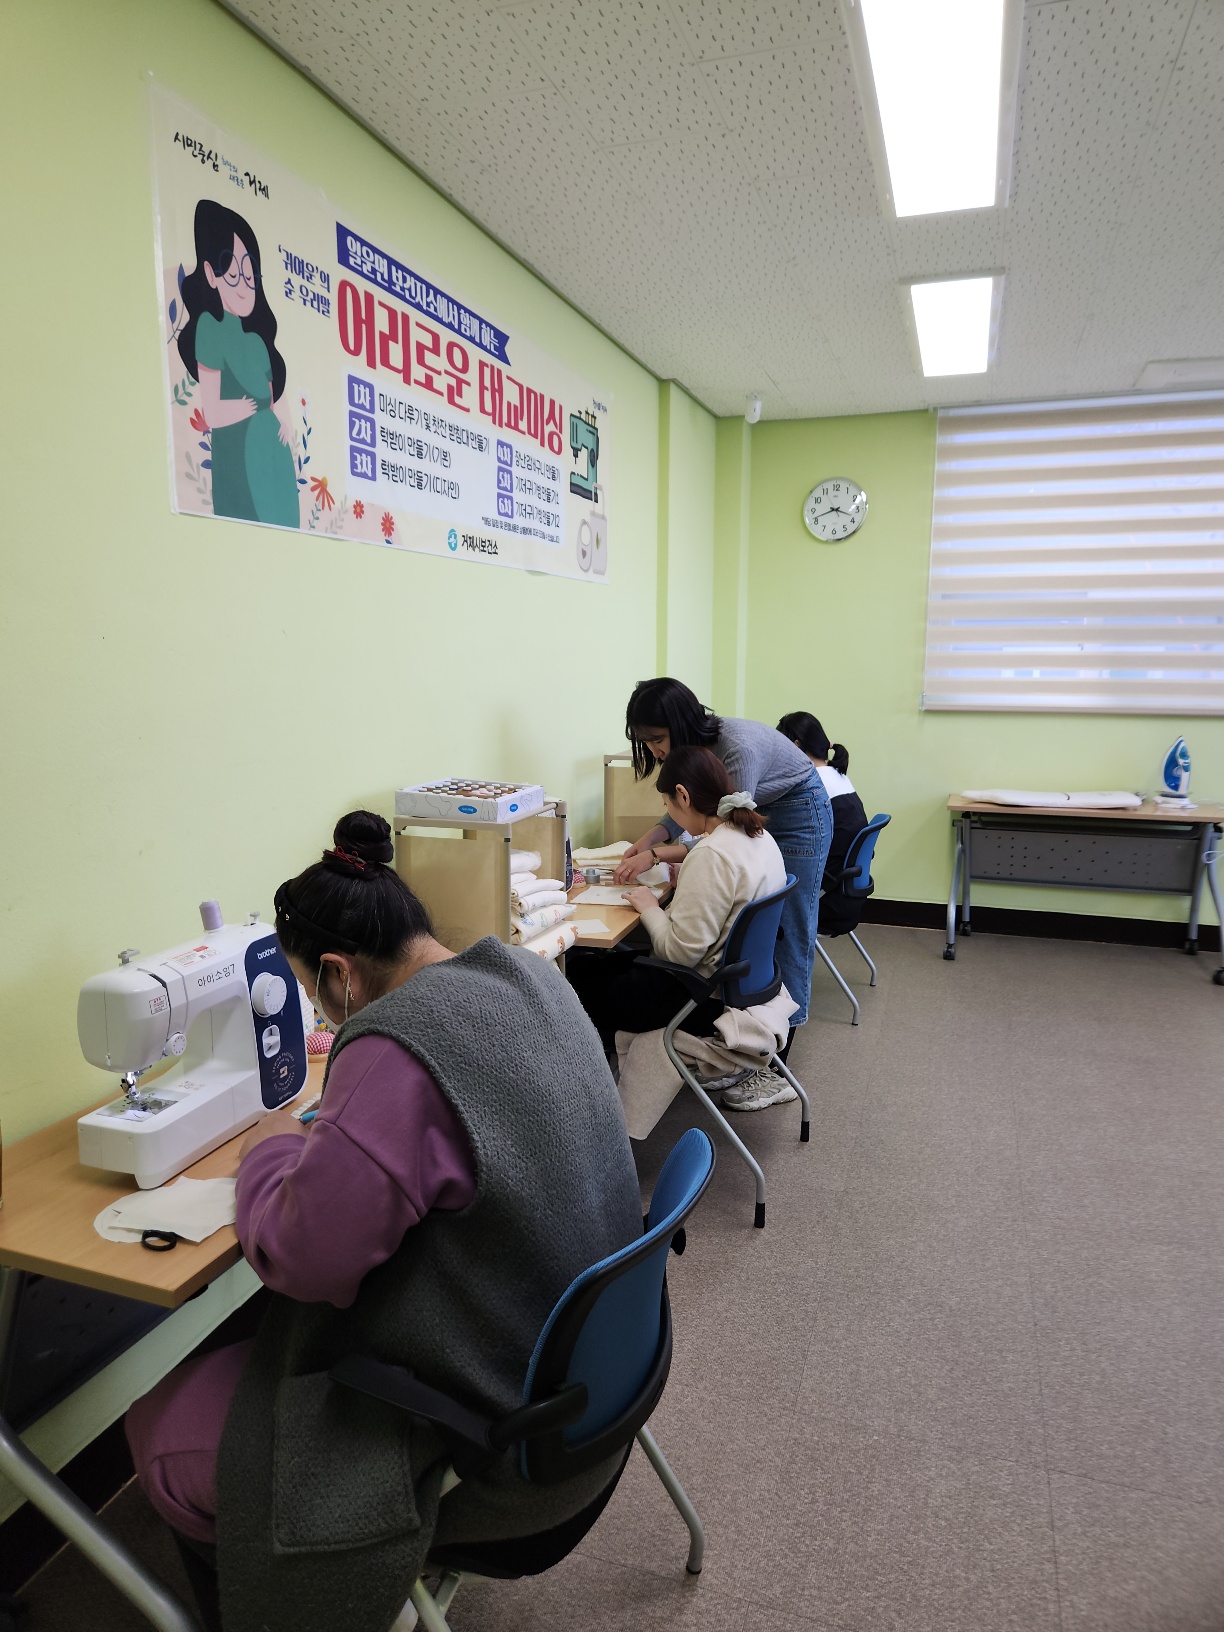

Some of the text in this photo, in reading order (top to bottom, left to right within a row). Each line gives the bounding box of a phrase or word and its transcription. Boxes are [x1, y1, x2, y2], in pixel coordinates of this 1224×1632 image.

[173, 131, 219, 172] 시민중심
[244, 171, 270, 201] 거제
[284, 277, 331, 319] 순 우리말
[346, 235, 500, 355] 일운면 보건지소에서 함께 하는
[337, 279, 563, 456] 어리로운 태교미싱
[351, 418, 372, 444] 2차
[380, 426, 407, 454] 턱받이
[352, 383, 371, 410] 1차
[379, 393, 397, 419] 미싱
[398, 401, 423, 429] 다루기
[423, 412, 432, 433] 및
[470, 432, 490, 455] 만들기
[353, 452, 372, 478] 3차
[381, 458, 407, 486] 턱받이
[497, 445, 511, 464] 4차
[499, 471, 511, 490] 5차
[832, 484, 840, 492] 12
[499, 497, 512, 516] 6차
[461, 533, 499, 555] 거제시보건소
[256, 946, 277, 960] brother
